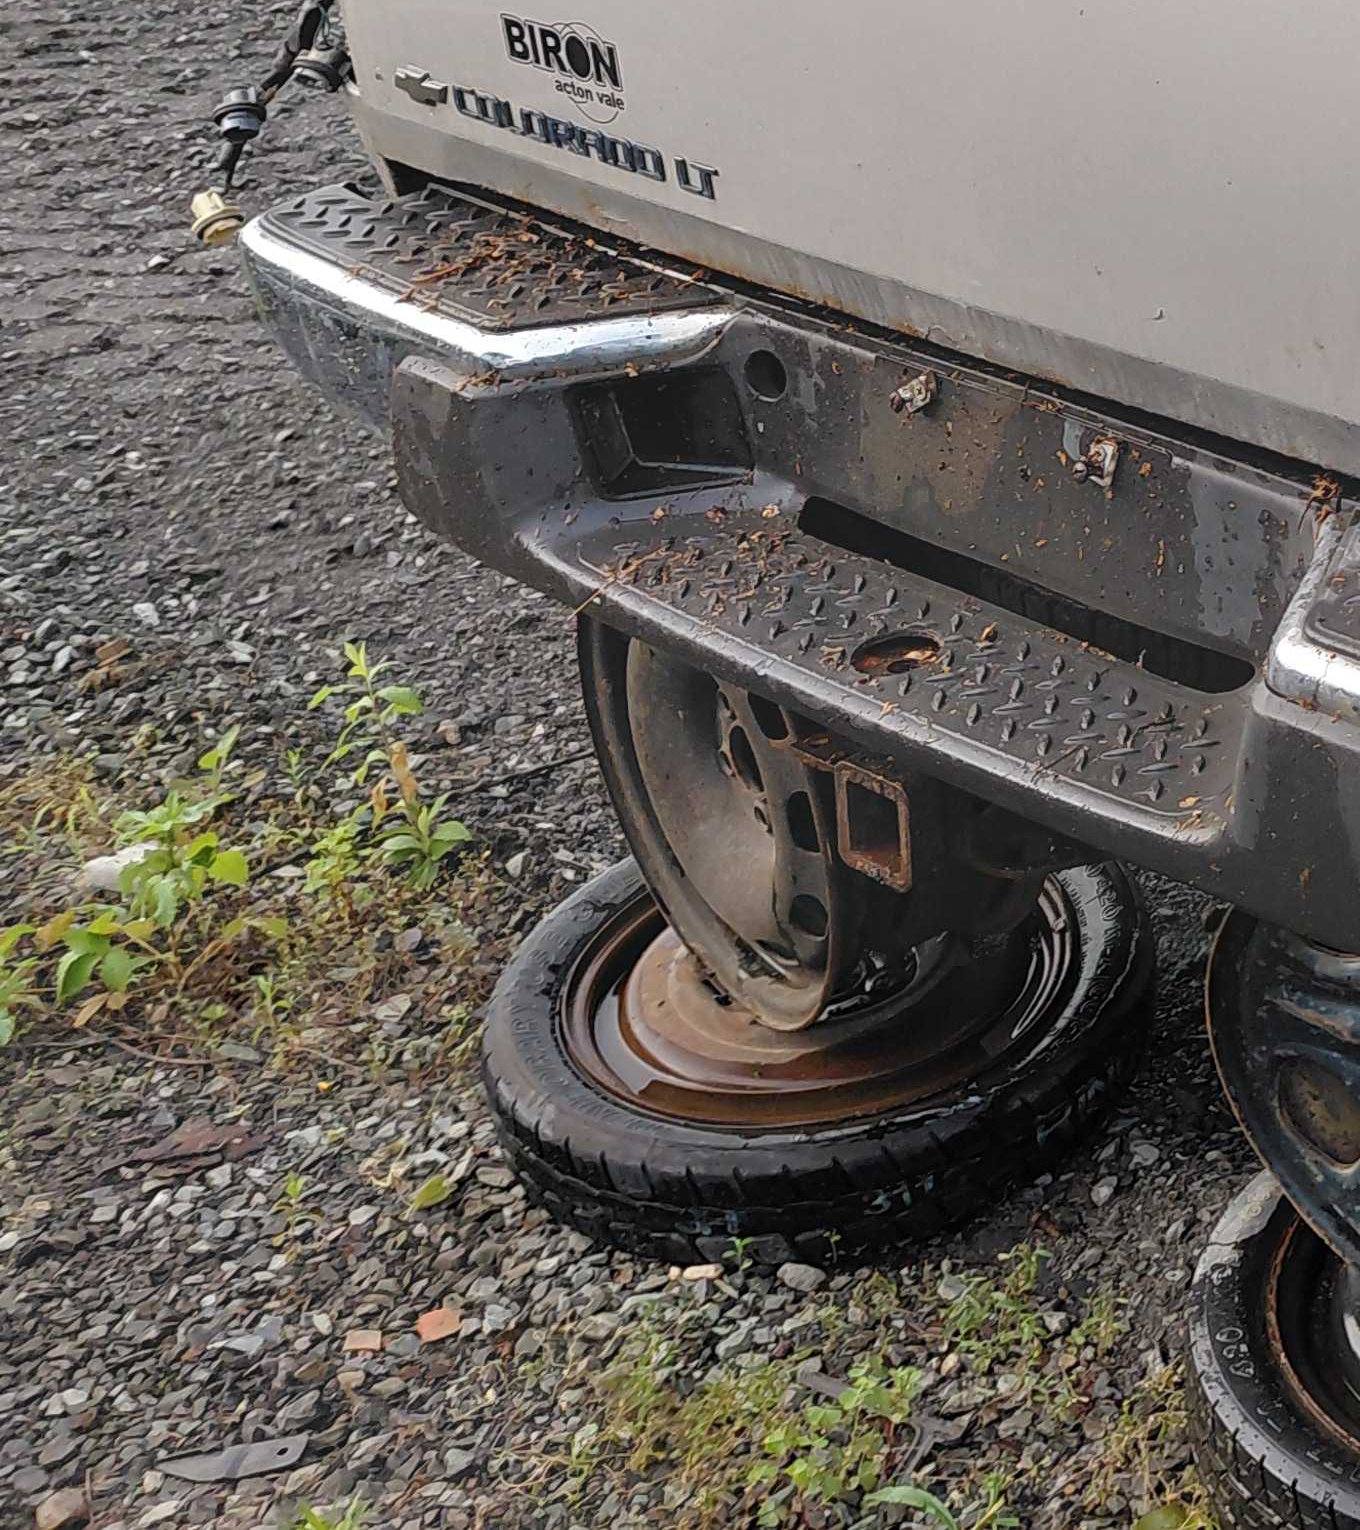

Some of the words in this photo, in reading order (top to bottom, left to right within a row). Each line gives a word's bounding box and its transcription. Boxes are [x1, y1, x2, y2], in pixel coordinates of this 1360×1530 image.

[501, 13, 622, 90] BIRON
[554, 77, 594, 103] acton
[596, 89, 625, 111] vale
[452, 85, 667, 183] COLORADO
[673, 156, 720, 200] LT
